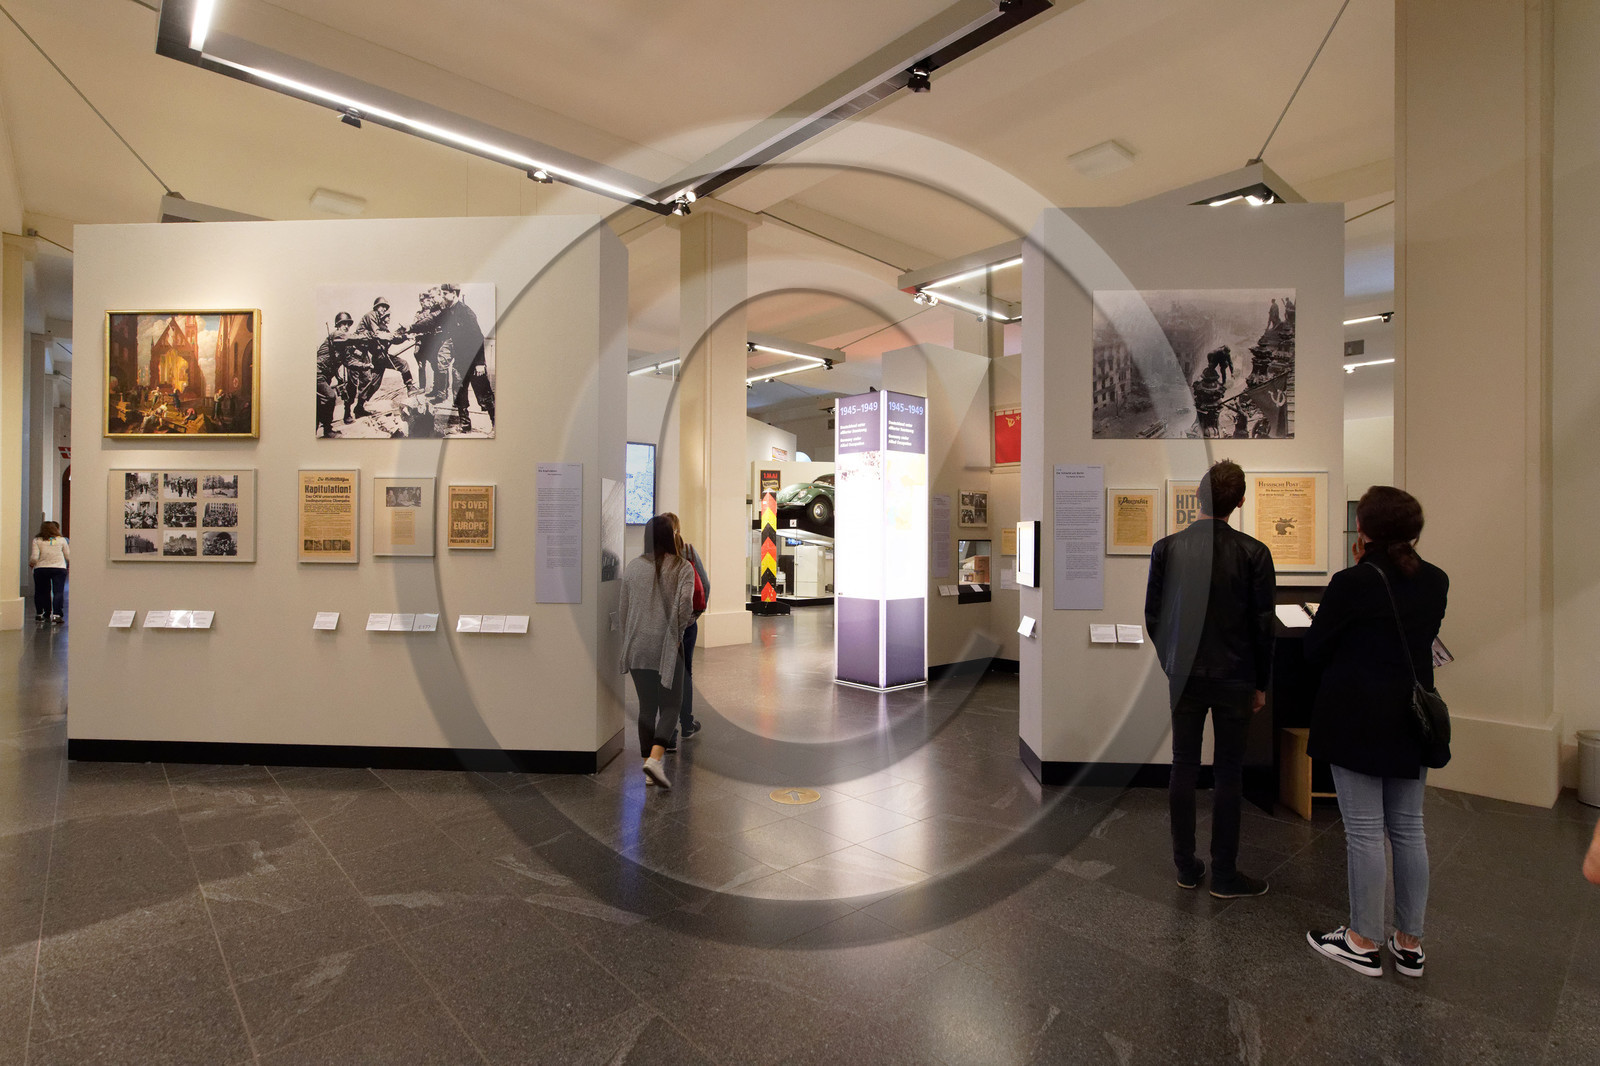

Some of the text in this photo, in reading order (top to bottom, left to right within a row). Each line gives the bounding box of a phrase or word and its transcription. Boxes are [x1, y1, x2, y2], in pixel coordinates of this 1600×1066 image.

[305, 485, 351, 494] Kapitulation!
[468, 501, 487, 509] OVER
[1176, 495, 1202, 509] HIT
[1176, 510, 1196, 524] DE
[454, 522, 486, 530] EUROPE!
